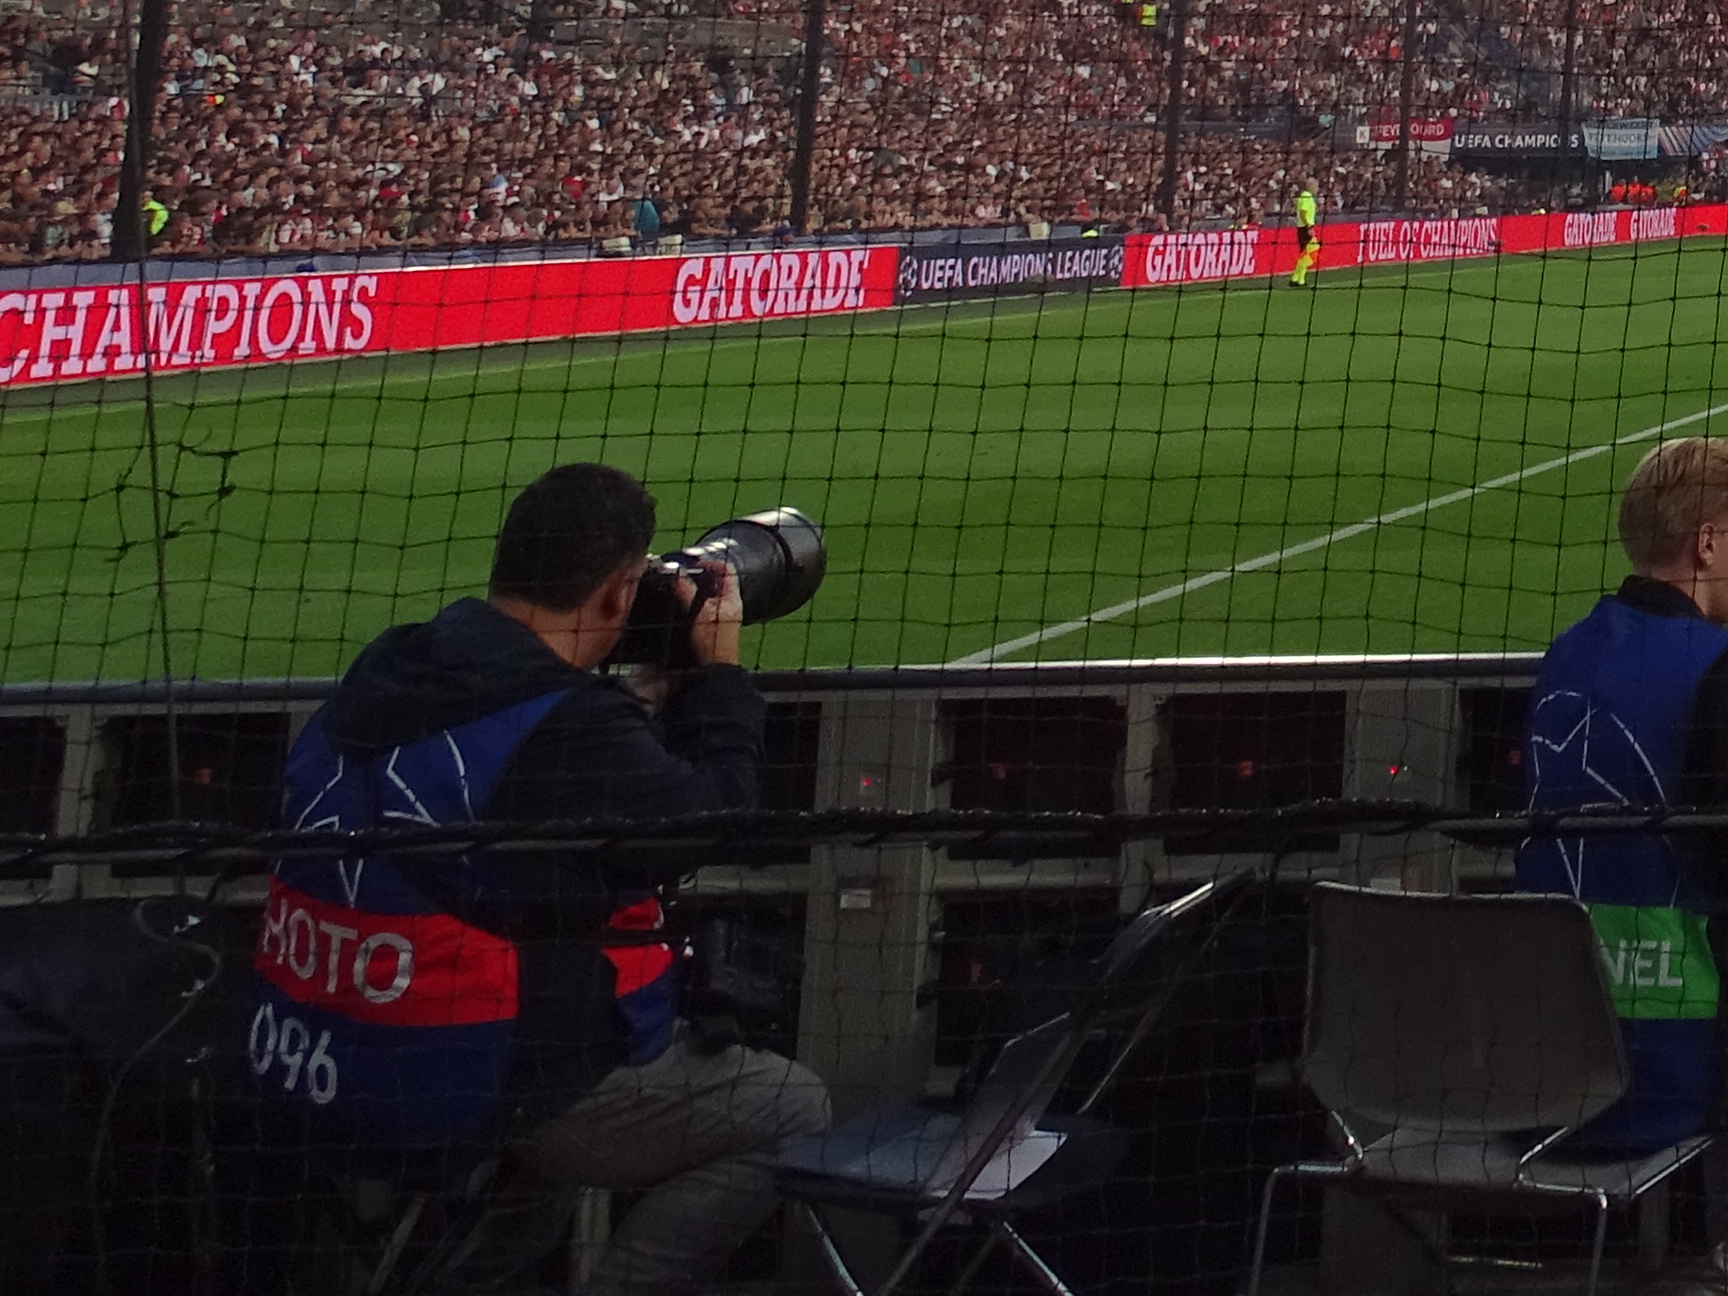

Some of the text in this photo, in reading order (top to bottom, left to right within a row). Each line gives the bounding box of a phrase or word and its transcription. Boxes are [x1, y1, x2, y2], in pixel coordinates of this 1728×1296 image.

[1376, 123, 1445, 137] FEYEOORD
[1455, 133, 1579, 148] UEFA CHAMPIOS
[1357, 217, 1498, 263] FUEL OF CHAMPIONS
[1563, 207, 1677, 247] GATORADE GATORADE
[921, 248, 1106, 290] UEFA CHAMPIONS LEAGUE
[1146, 229, 1259, 283] GATORADE
[673, 249, 870, 324] GATORADE
[0, 274, 378, 383] CHAMPIONS
[263, 898, 415, 1004] HOTO
[1599, 938, 1683, 987] NEL
[250, 1002, 338, 1105] 096
